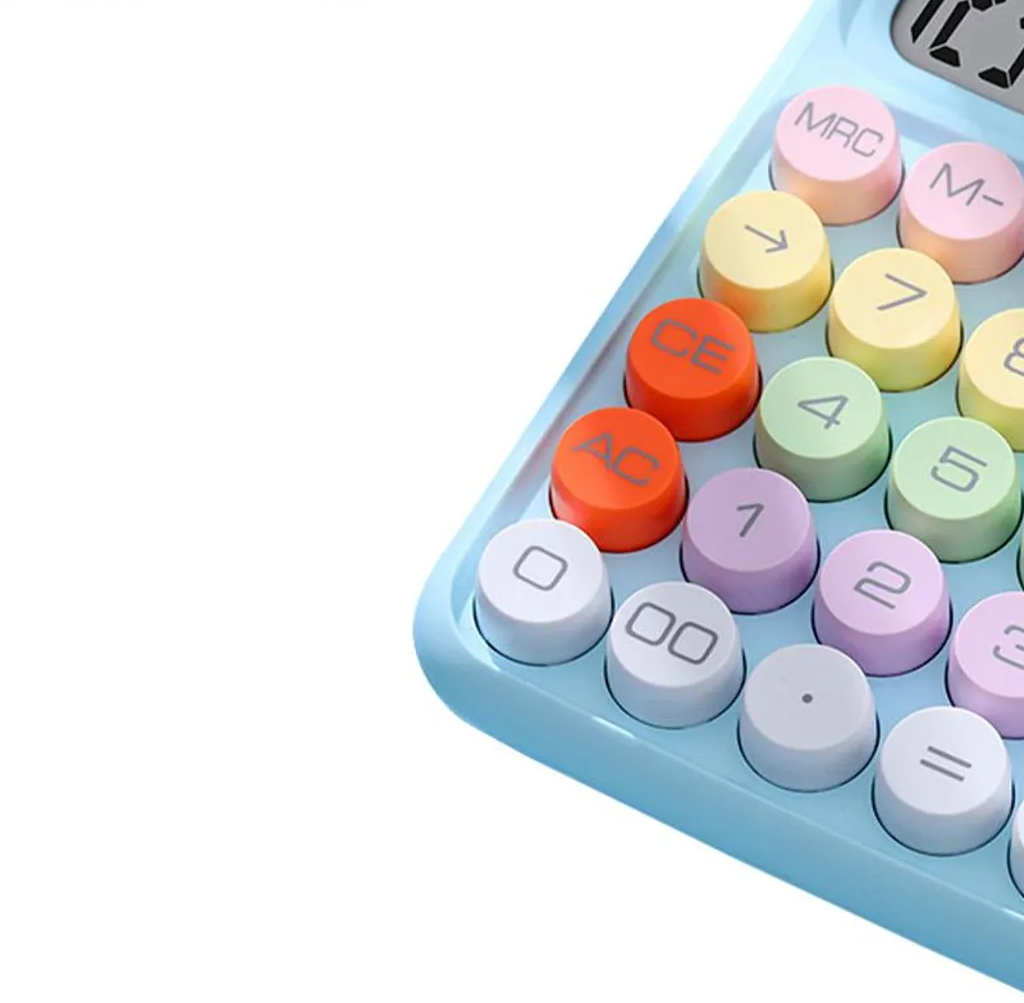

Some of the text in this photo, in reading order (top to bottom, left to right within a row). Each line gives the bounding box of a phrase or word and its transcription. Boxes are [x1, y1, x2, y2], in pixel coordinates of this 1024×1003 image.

[793, 101, 884, 158] MRC
[876, 272, 928, 312] 7
[650, 318, 735, 375] CE
[797, 394, 849, 430] 4
[573, 432, 660, 487] AC
[930, 446, 988, 493] 5
[735, 502, 764, 538] 1
[512, 545, 569, 592] 0
[853, 561, 912, 610] 2
[625, 601, 718, 665] 00
